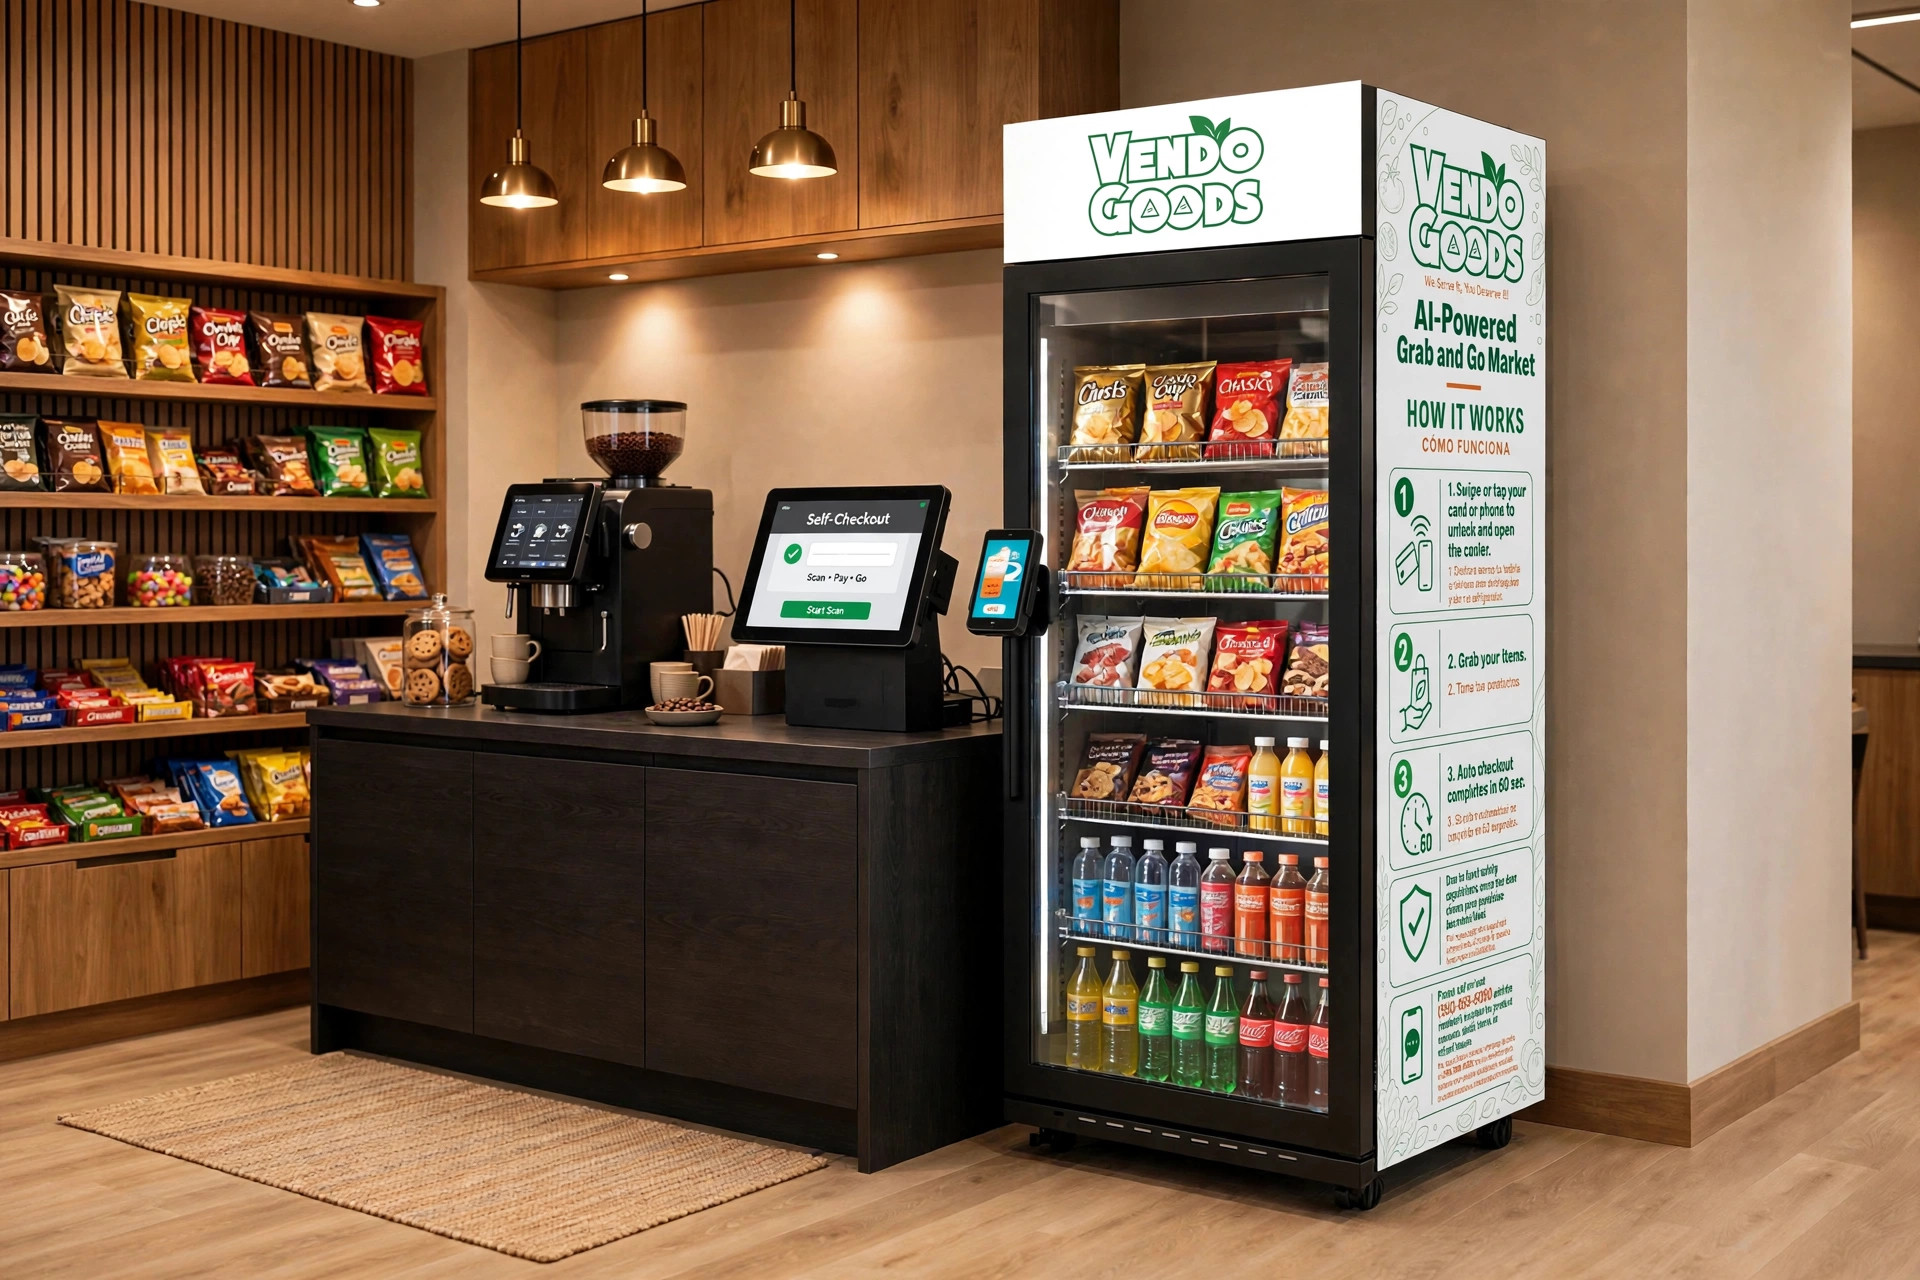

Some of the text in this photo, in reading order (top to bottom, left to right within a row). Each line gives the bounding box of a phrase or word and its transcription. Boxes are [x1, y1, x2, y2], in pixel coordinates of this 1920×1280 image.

[1088, 126, 1264, 186] VENDO
[1409, 143, 1524, 230] VENDO
[1088, 179, 1264, 236] GOODS
[1409, 203, 1523, 283] GOODS
[1414, 299, 1517, 343] AI-Powered
[1397, 335, 1535, 377] Grab and Go Market
[1407, 399, 1524, 434] HOW IT WORKS
[1422, 435, 1510, 456] CÓMO FUNCIONA
[1399, 484, 1407, 511] 1
[1448, 482, 1455, 497] 1.
[1483, 486, 1492, 497] or
[1508, 487, 1526, 501] your
[806, 511, 891, 526] Self-Checkout
[1469, 507, 1478, 517] or
[1506, 502, 1515, 517] to
[1448, 543, 1462, 558] the
[807, 573, 867, 584] Scan Pay Go
[826, 606, 844, 615] Scan
[1399, 638, 1407, 666] 2
[1448, 653, 1456, 669] 2.
[1458, 651, 1479, 668] Grab
[1481, 653, 1500, 669] your
[1399, 763, 1408, 794] 3
[1447, 766, 1455, 782] 3.
[1457, 764, 1476, 781] Auto
[1489, 780, 1497, 794] in
[1499, 776, 1509, 793] 60
[1420, 833, 1432, 854] 60
